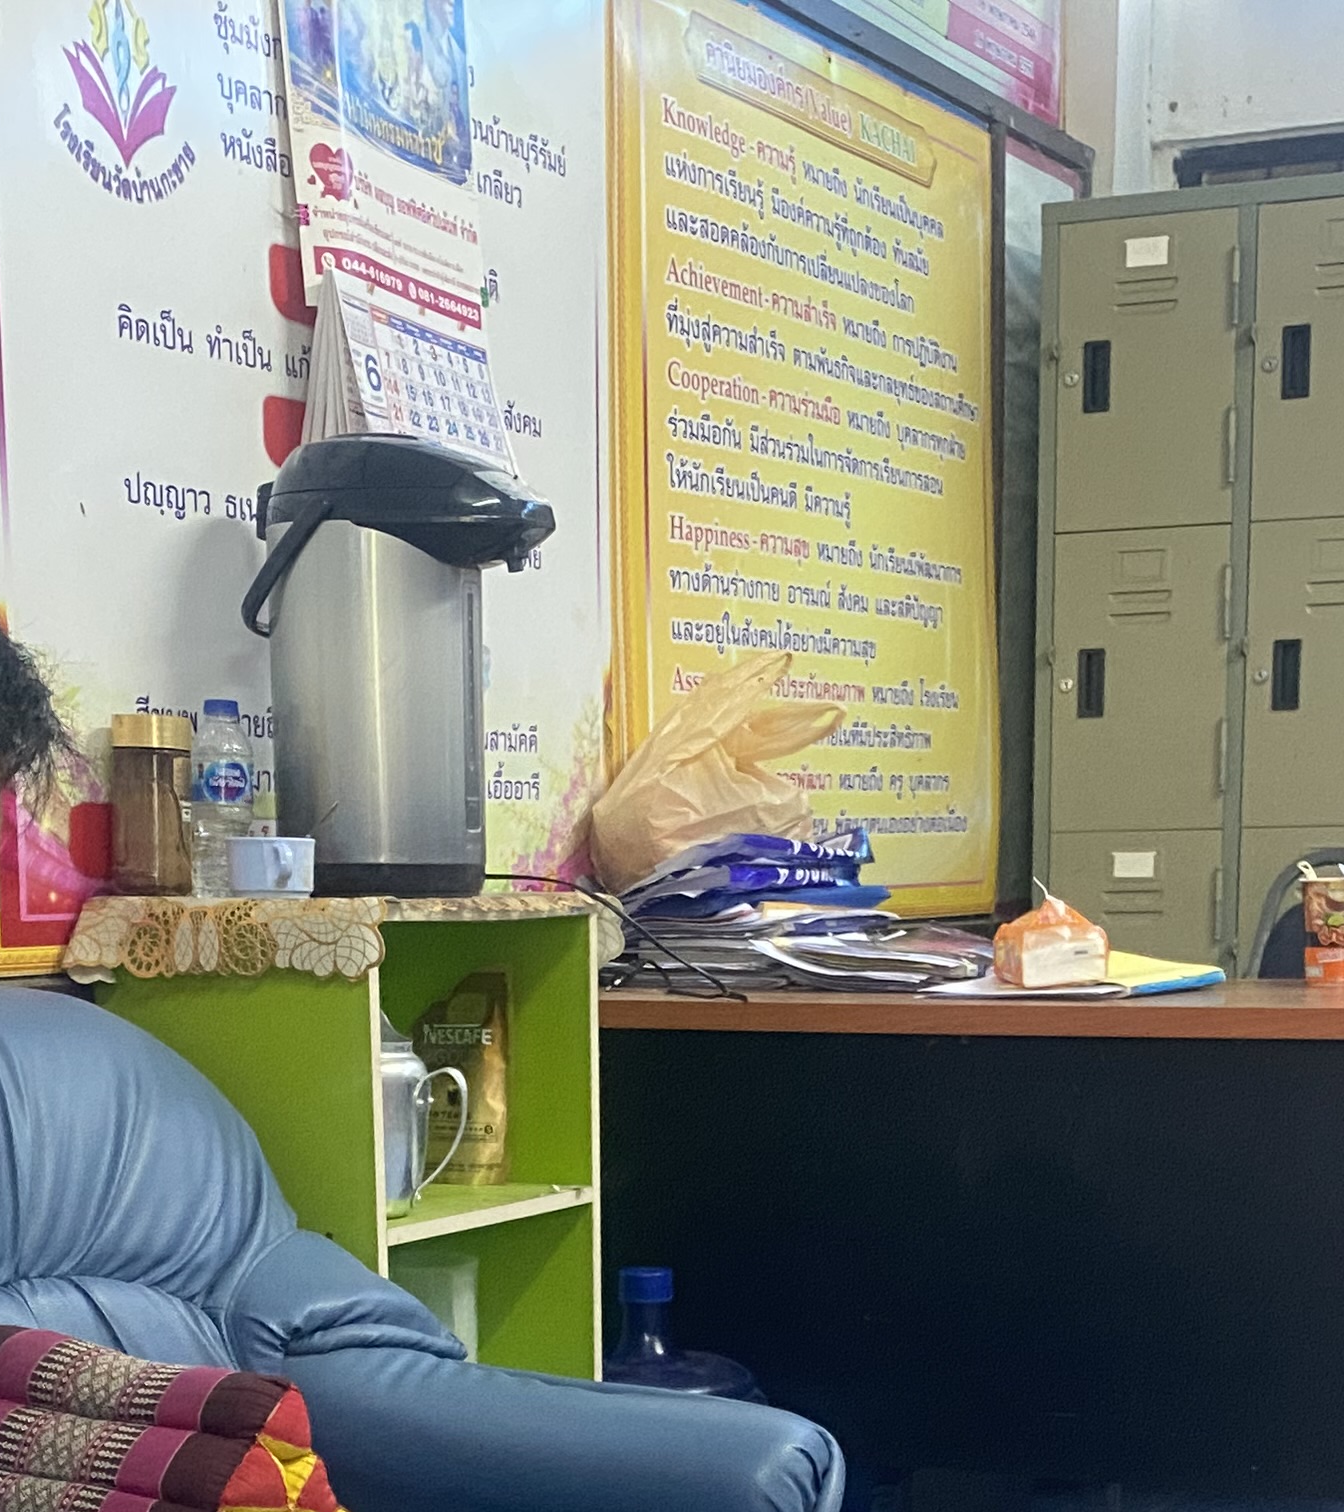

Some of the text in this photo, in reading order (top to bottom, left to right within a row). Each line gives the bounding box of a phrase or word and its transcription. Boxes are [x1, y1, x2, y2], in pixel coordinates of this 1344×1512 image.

[117, 302, 194, 355] คิดเป็น
[205, 323, 273, 373] ทำเป็น
[364, 353, 383, 392] 6
[484, 723, 539, 755] สามัคคี
